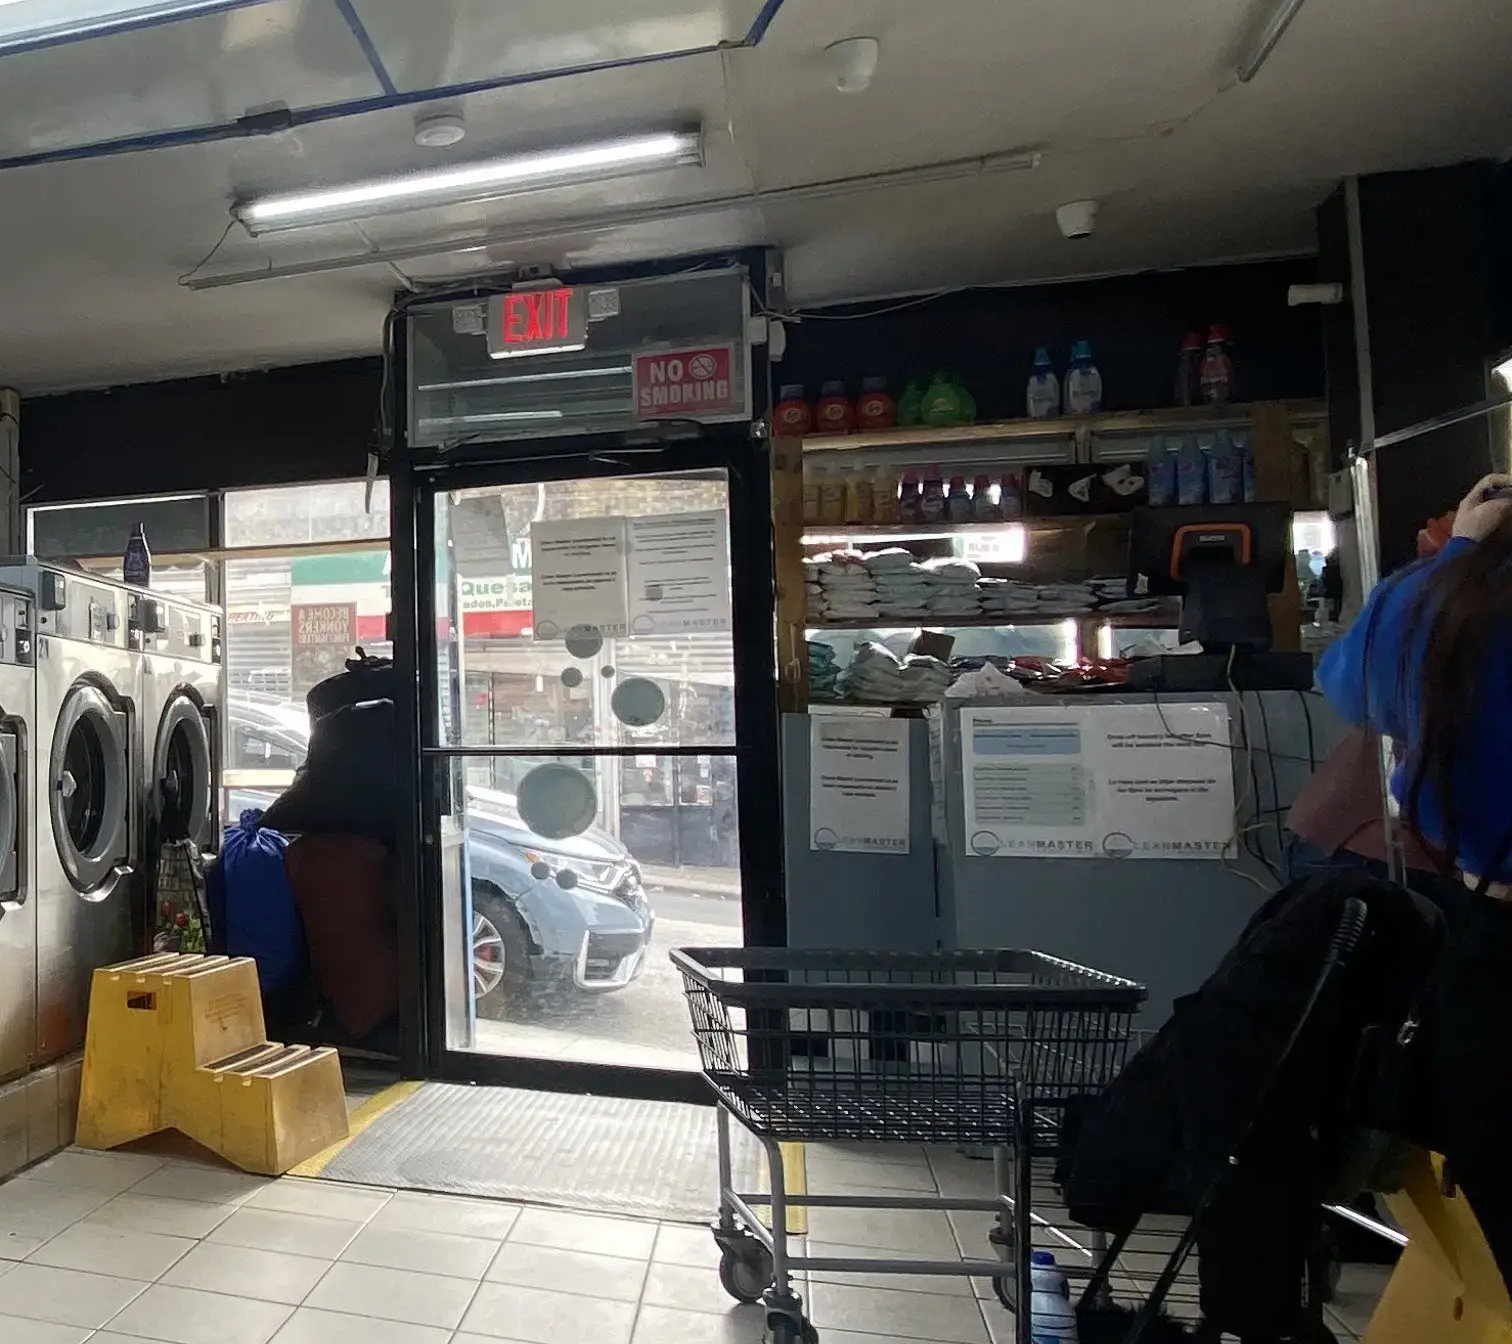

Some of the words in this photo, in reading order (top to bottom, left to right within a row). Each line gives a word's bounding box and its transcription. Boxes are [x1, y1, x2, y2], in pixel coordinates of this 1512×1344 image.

[503, 287, 573, 343] EXIT
[650, 359, 683, 383] NO
[640, 380, 728, 406] SMOKING
[462, 581, 532, 596] Quea
[38, 638, 49, 659] 21
